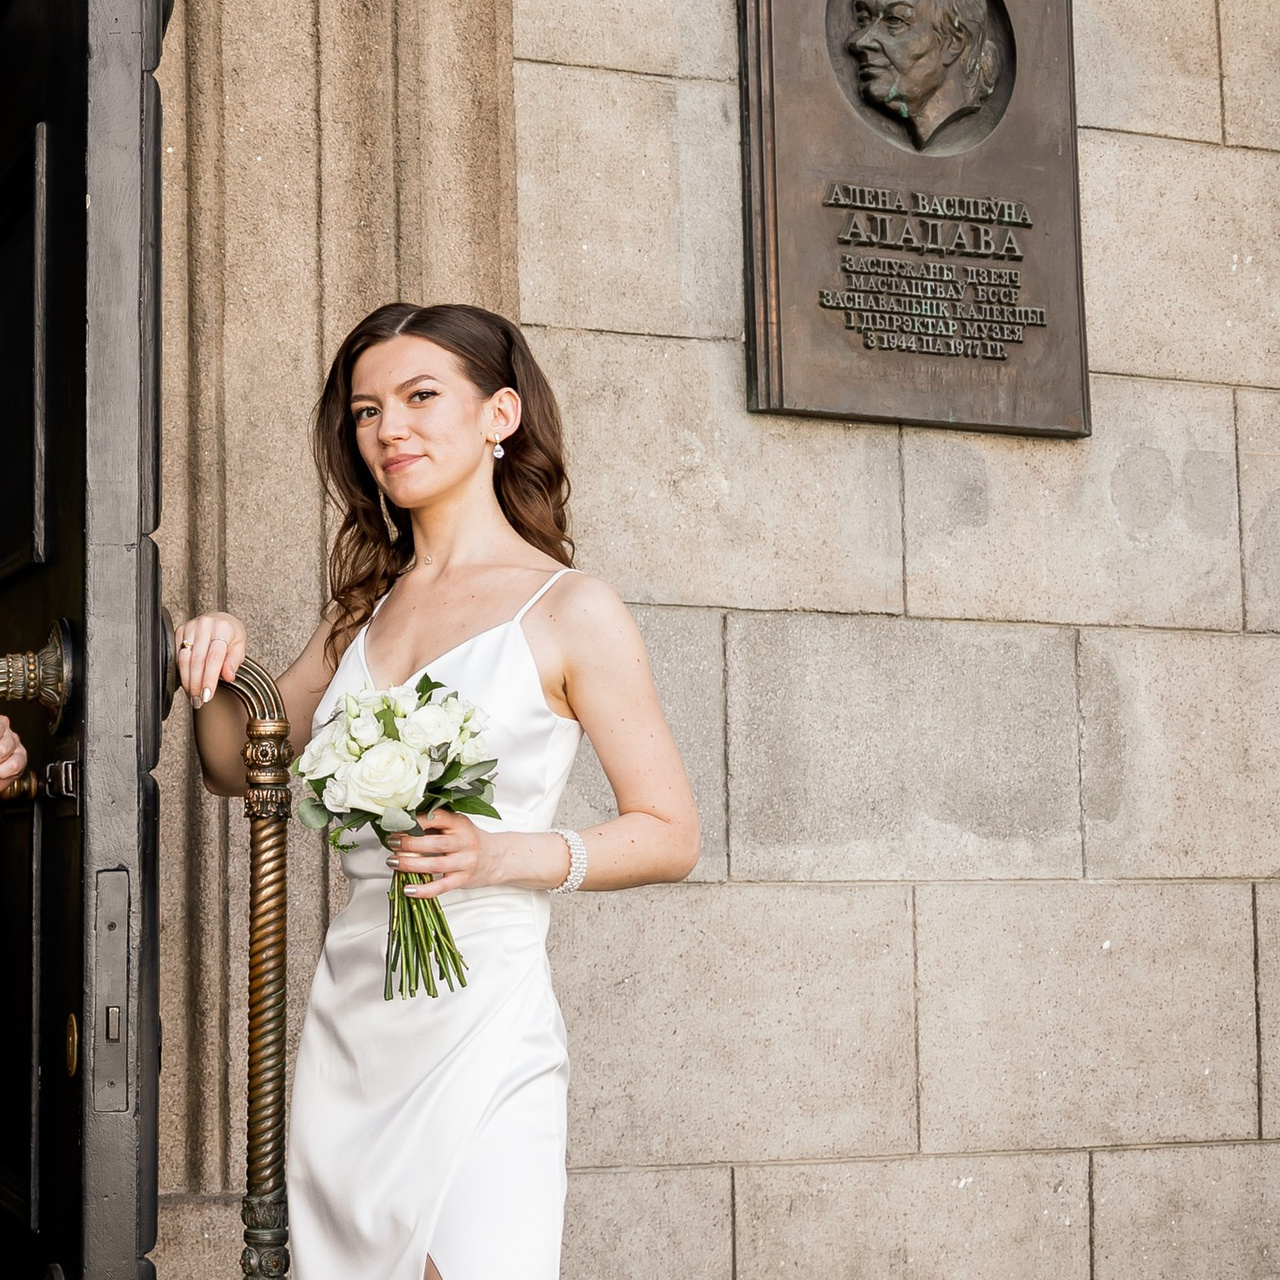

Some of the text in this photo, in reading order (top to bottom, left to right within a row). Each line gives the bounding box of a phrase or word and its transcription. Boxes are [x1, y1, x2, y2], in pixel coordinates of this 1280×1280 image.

[826, 184, 1033, 224] АЛЕНА ВАСІЛЕЎНА
[840, 213, 1023, 258] АЛАДАВА
[842, 255, 1021, 286] ЗАСЛУЖАНЫ ДЗЕЯЧ
[848, 274, 1021, 304] МАСТАЦТВАЎ БССР
[821, 290, 1047, 326] ЗАСНАВАЛЬНІК КАЛЕКЦЫІ
[859, 312, 958, 336] ДЫРЭКТАР
[964, 321, 1024, 341] МУЗЕЯ
[880, 333, 917, 351] 1944
[920, 335, 946, 353] ПА
[948, 338, 981, 357] 1977
